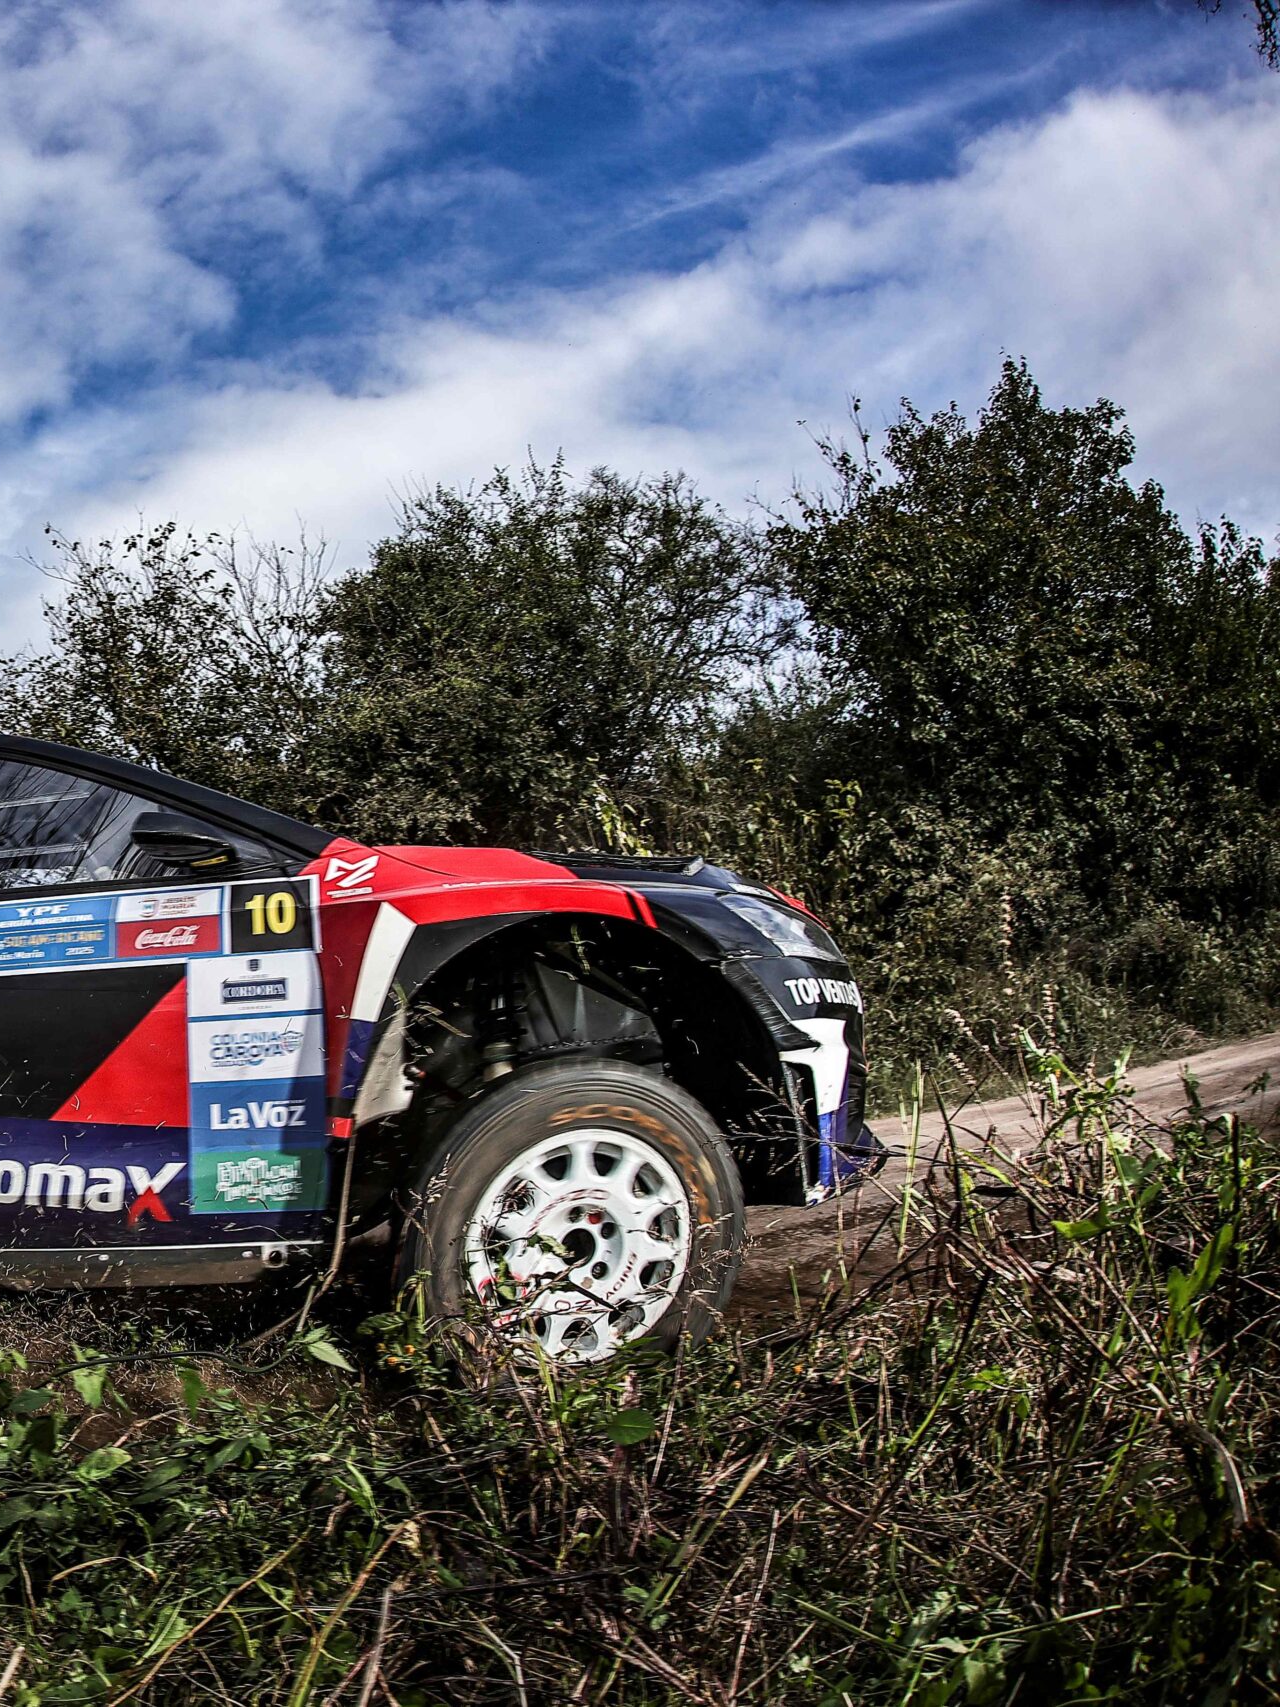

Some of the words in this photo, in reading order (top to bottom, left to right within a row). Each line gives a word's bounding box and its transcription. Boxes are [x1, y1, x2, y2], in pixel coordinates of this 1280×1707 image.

[16, 904, 70, 918] YPF
[244, 891, 297, 935] 10
[783, 978, 820, 1006] TOP
[209, 1043, 284, 1060] CAROYA
